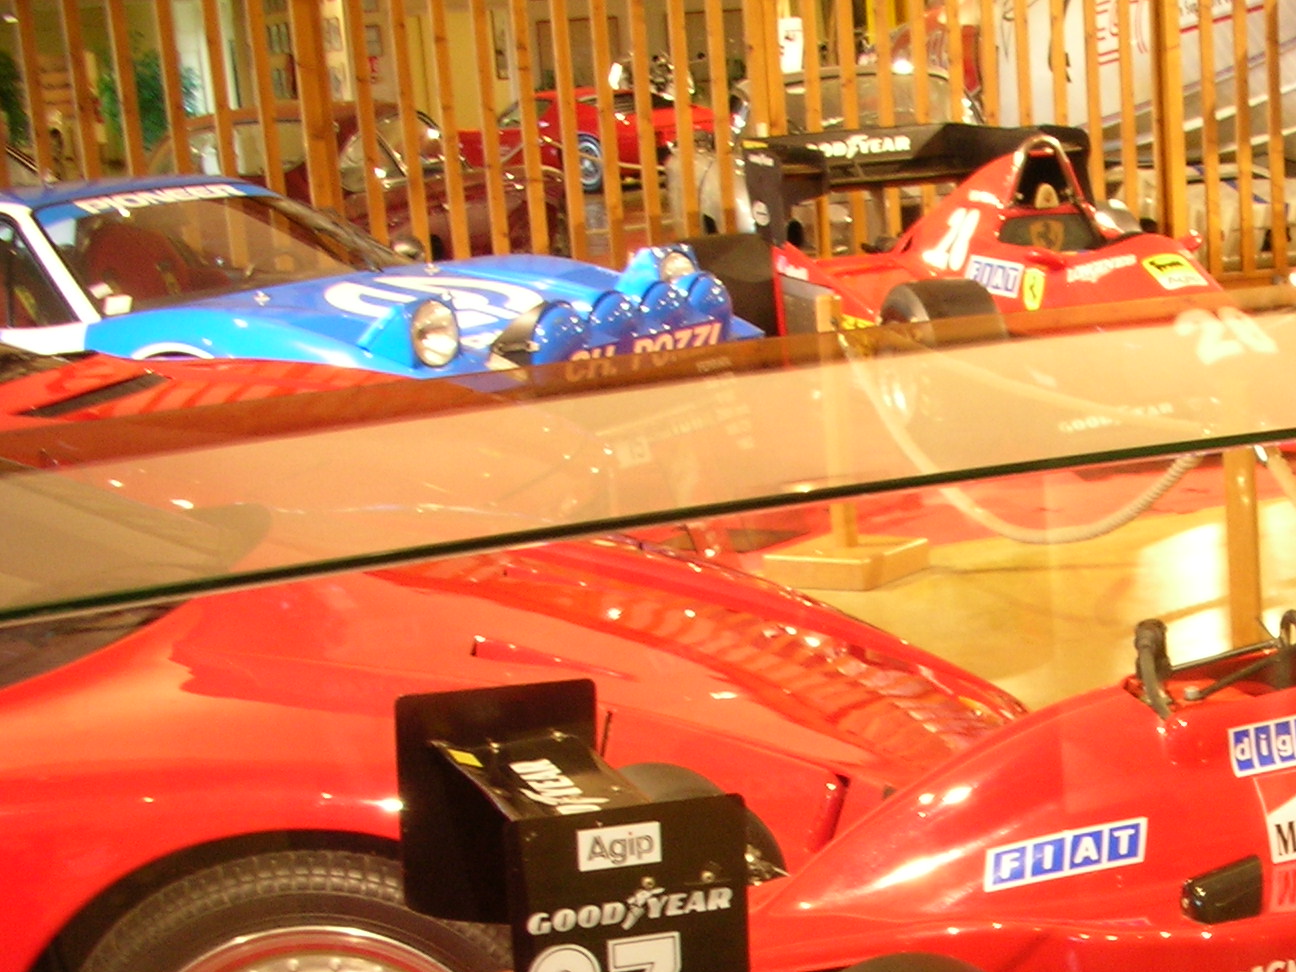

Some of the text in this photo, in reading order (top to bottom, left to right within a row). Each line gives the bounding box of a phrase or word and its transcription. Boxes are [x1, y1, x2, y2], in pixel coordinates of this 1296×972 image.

[806, 134, 912, 158] OODYEAR
[73, 183, 247, 214] PIONEER
[630, 322, 723, 371] POZZI
[586, 832, 654, 865] Agip
[1000, 829, 1136, 880] FIAT
